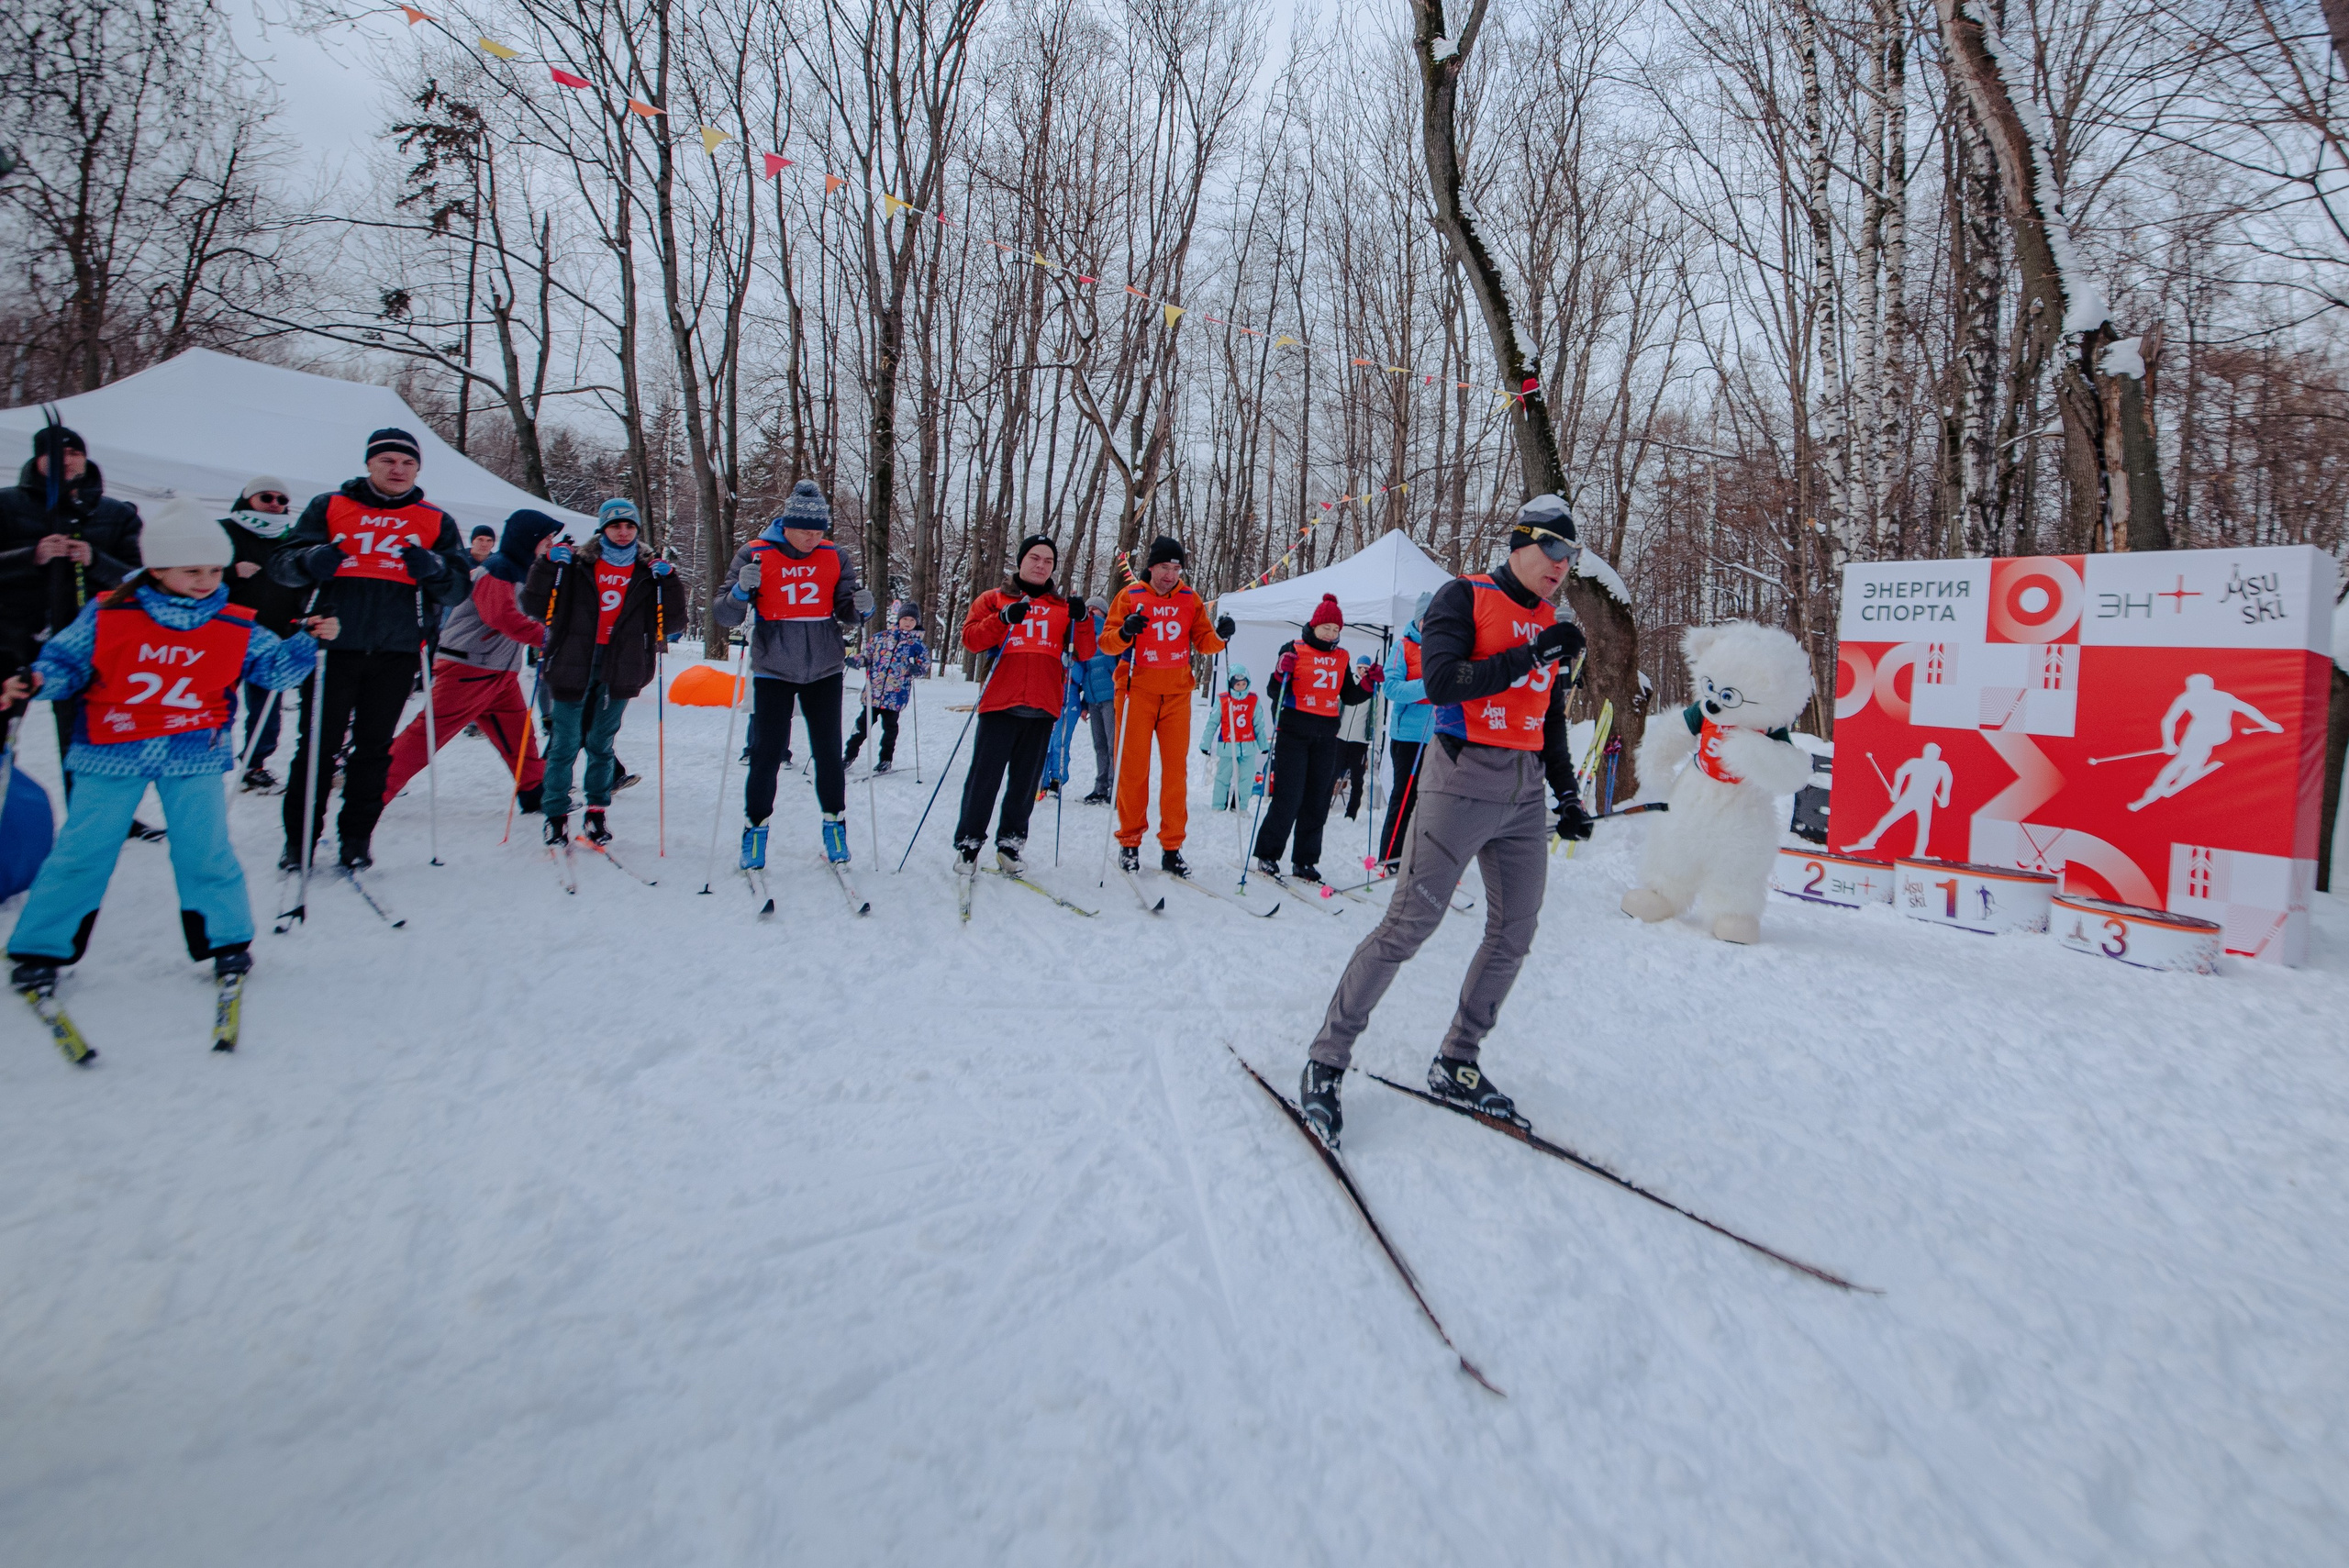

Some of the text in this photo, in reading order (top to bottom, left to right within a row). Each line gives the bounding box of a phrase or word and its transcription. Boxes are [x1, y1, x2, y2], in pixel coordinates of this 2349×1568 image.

[360, 515, 409, 529] МГУ
[353, 531, 404, 559] 14
[598, 573, 631, 587] МГУ
[781, 565, 817, 578] МГУ
[780, 582, 820, 606] 12
[1863, 580, 1971, 599] ЭНЕРГИЯ
[601, 590, 622, 612] 9
[1152, 606, 1179, 617] МГУ
[1862, 604, 1957, 622] СПОРТА
[1021, 617, 1049, 639] 11
[1152, 620, 1182, 641] 19
[139, 643, 206, 667] МГУ
[1313, 656, 1337, 666] МГУ
[1312, 668, 1338, 690] 21
[124, 672, 204, 709] 24
[1236, 713, 1247, 728] 6
[1803, 861, 1825, 896] 2
[1935, 878, 1958, 917] 1
[2101, 919, 2127, 957] 3
